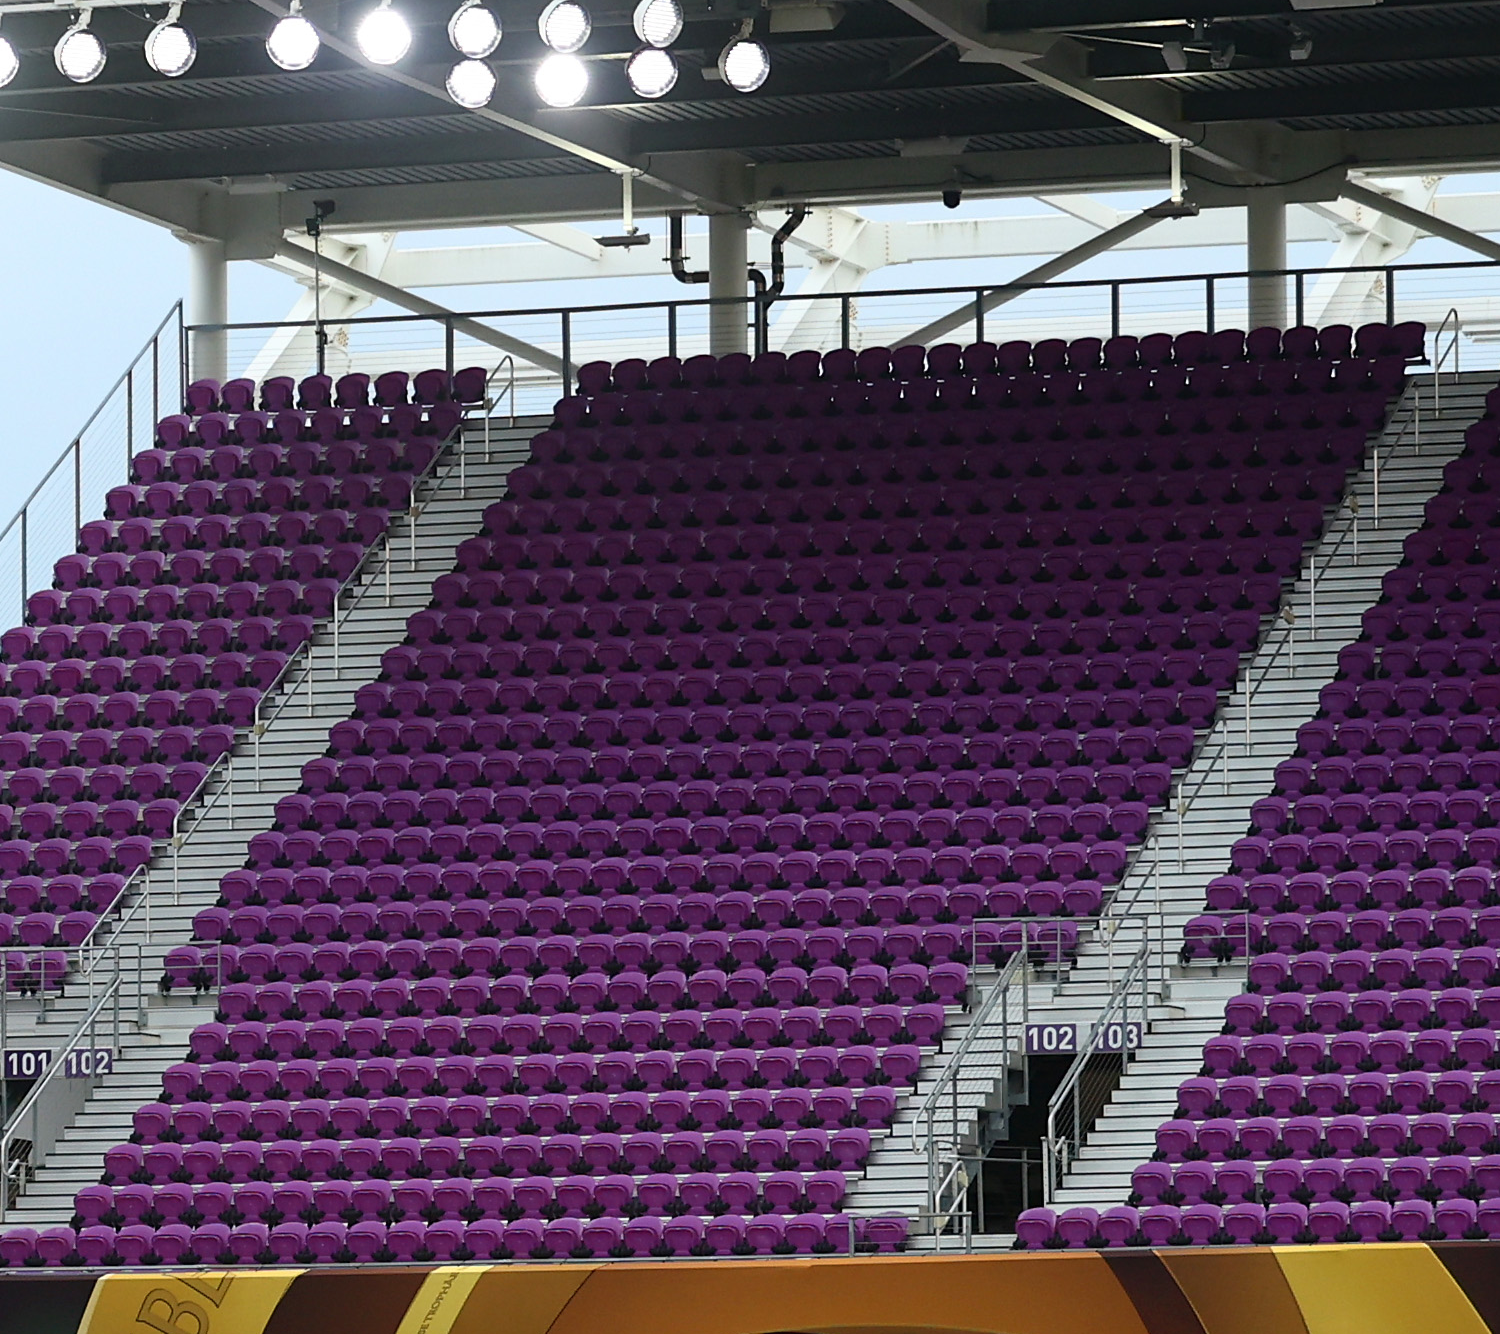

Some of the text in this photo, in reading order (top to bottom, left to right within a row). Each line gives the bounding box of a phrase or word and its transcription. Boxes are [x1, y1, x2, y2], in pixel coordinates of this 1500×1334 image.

[1029, 1027, 1073, 1051] 102
[9, 1052, 47, 1075] 101
[68, 1051, 109, 1075] 102
